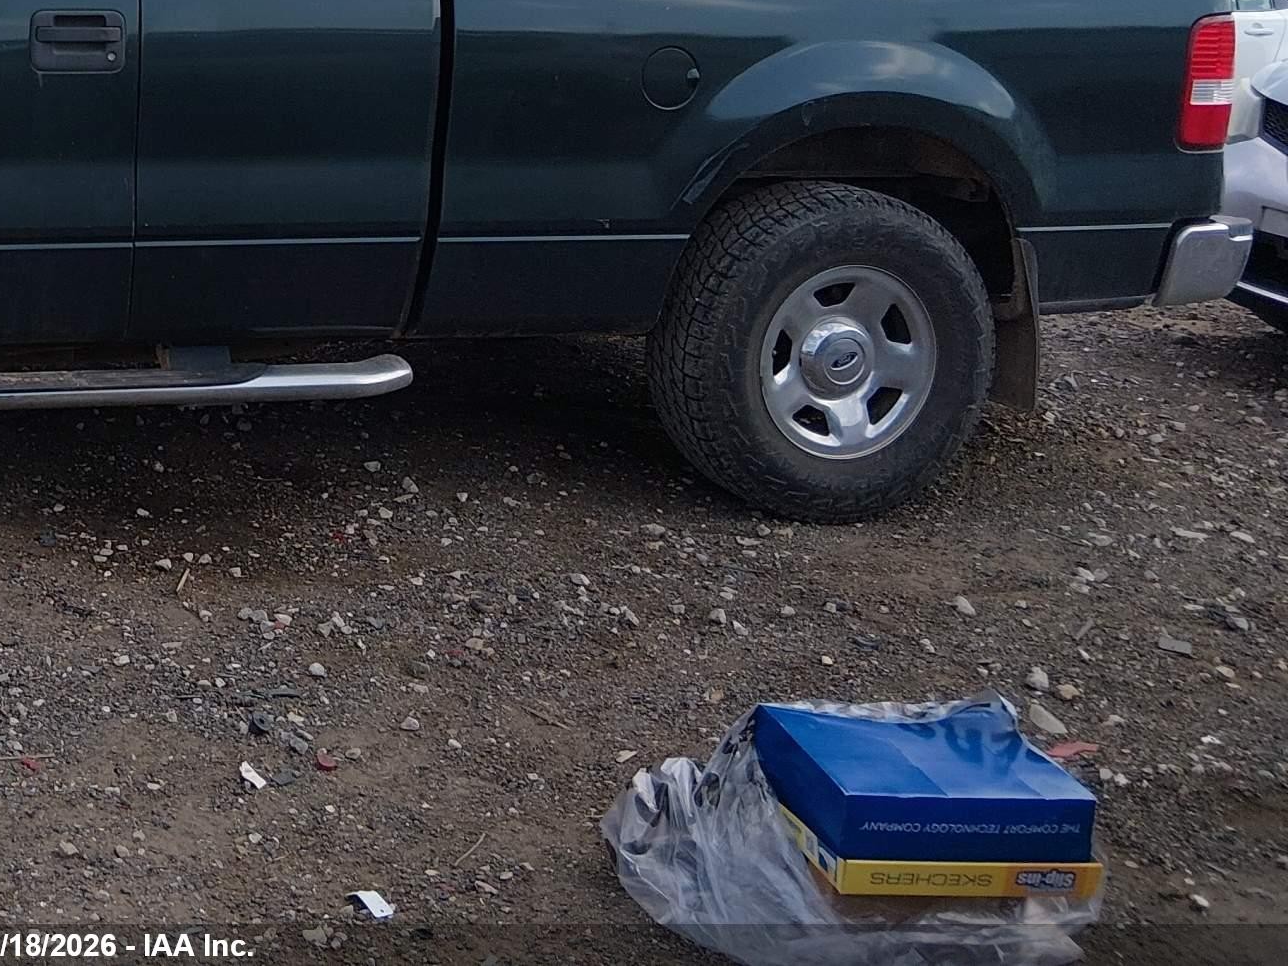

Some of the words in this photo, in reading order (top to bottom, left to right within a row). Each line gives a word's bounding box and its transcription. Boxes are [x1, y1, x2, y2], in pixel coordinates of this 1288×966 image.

[859, 821, 921, 832] COMPANY
[923, 823, 1000, 833] TECHNOLOGY
[1003, 824, 1058, 834] COMFORT
[1060, 823, 1080, 833] THE
[870, 872, 993, 886] SKECHERS
[1016, 870, 1075, 888] Slip-ins
